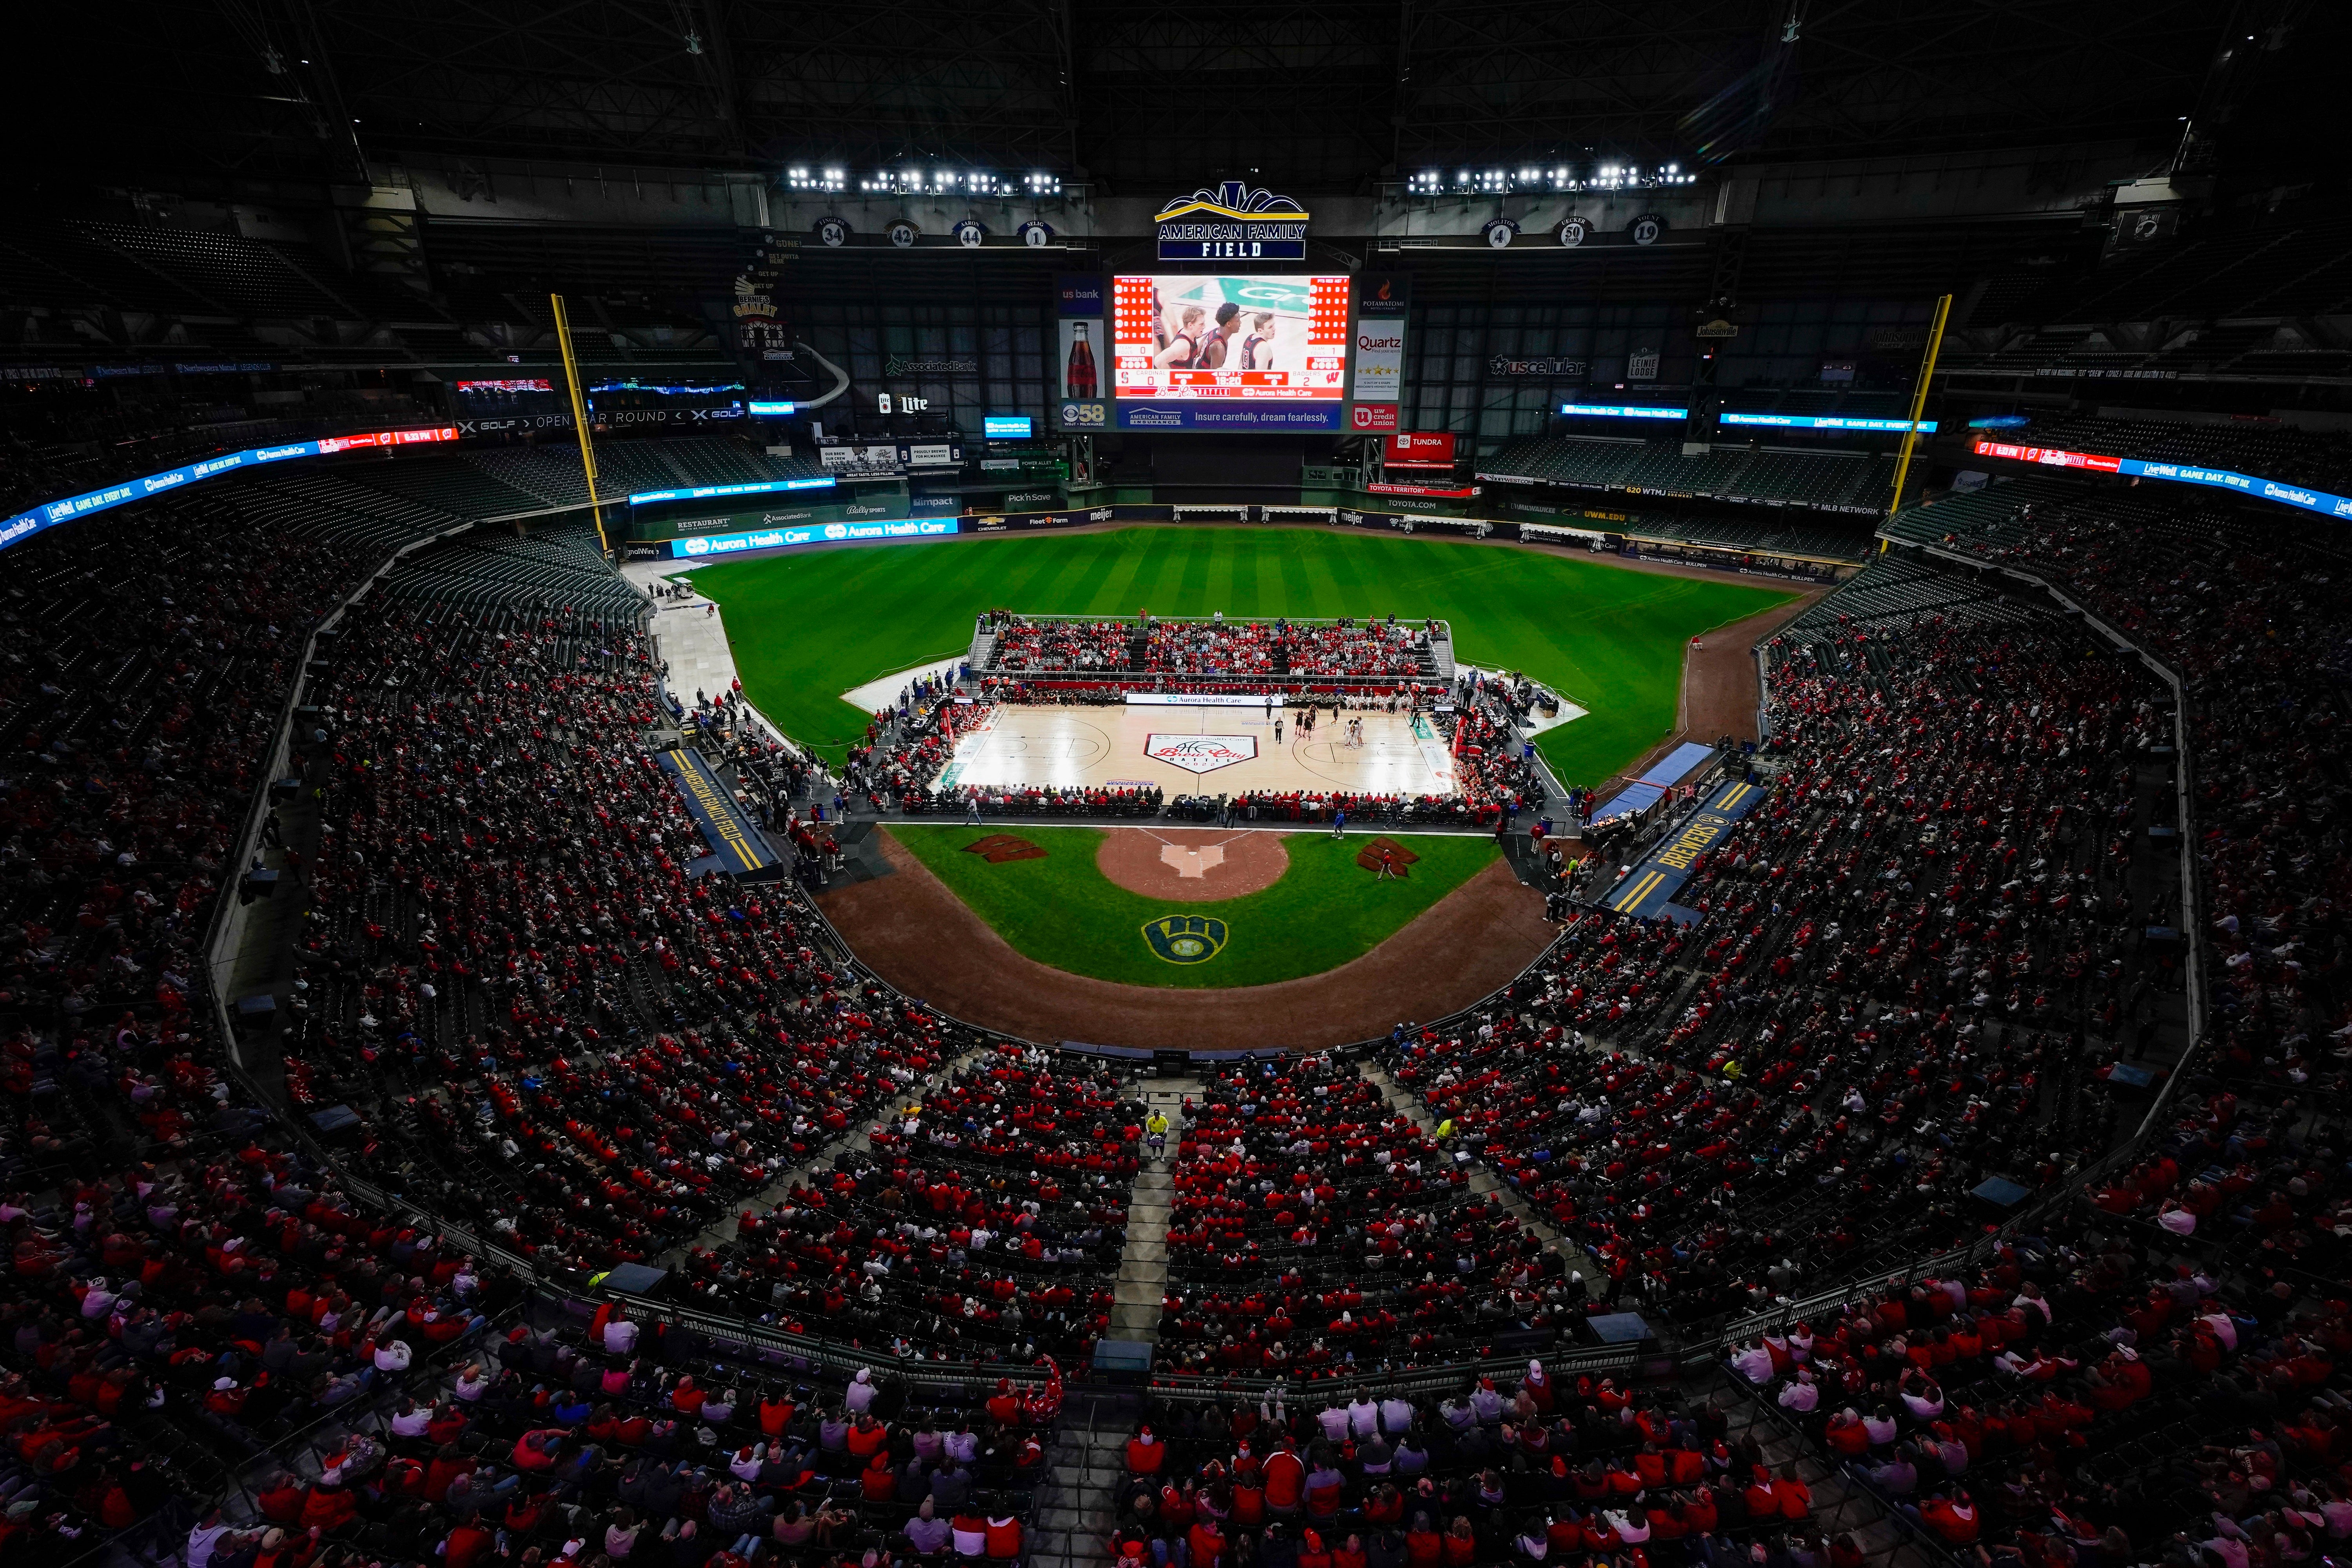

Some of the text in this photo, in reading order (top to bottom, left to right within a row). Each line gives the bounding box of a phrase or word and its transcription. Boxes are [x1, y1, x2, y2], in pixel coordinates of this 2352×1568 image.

[819, 218, 845, 226] FINGERS
[1488, 219, 1515, 228] MOLITOR
[824, 228, 843, 241] 34
[894, 230, 911, 243] 42
[963, 231, 980, 244] 44
[1158, 224, 1306, 239] AMERICAN FAMILY
[1495, 230, 1504, 243] 4
[1565, 226, 1580, 238] 50
[1636, 226, 1655, 240] 19
[1033, 232, 1040, 245] 1
[1202, 242, 1261, 256] FIELD
[739, 295, 770, 304] BERNIE'S
[1076, 289, 1098, 298] bank
[733, 303, 777, 317] CHALET
[1698, 327, 1736, 336] Johnsonville
[1358, 336, 1401, 351] Quartz
[1633, 359, 1655, 368] LEINIE
[1631, 368, 1654, 376] LODGE
[1148, 377, 1154, 385] 0
[1303, 377, 1309, 386] 2
[902, 397, 928, 414] Lite
[537, 411, 666, 428] OPEN EAR ROUND
[711, 410, 745, 419] GOLF
[1079, 405, 1105, 422] 58
[1195, 412, 1328, 422] Insure carefully, dream fearlessly.
[481, 420, 515, 430] GOLF
[2144, 464, 2249, 488] LiveWell GAME DAY. EVERY DAY.
[76, 487, 132, 511] GAME DAY. EVERY DAY.
[920, 497, 953, 506] impact
[2273, 487, 2317, 505] Aurora Health Care
[47, 501, 75, 519] LiveWell
[847, 506, 868, 515] Bally
[1388, 500, 1436, 509] TOYOTA.COM
[1839, 506, 1879, 515] NETWORK
[1091, 509, 1112, 522] meijer
[1341, 512, 1363, 525] meijer
[1584, 510, 1625, 521] UWM.EDU
[1, 518, 36, 541] Aurora Health Care
[677, 518, 728, 528] RESTAURANT
[848, 522, 946, 536] Aurora Health Care
[710, 531, 811, 551] Aurora Health Care
[1154, 748, 1247, 759] Brew City
[710, 781, 731, 808] WELCOME
[681, 770, 742, 840] AMERICAN FAMILY FIELD
[1658, 823, 1719, 869] BREWERS
